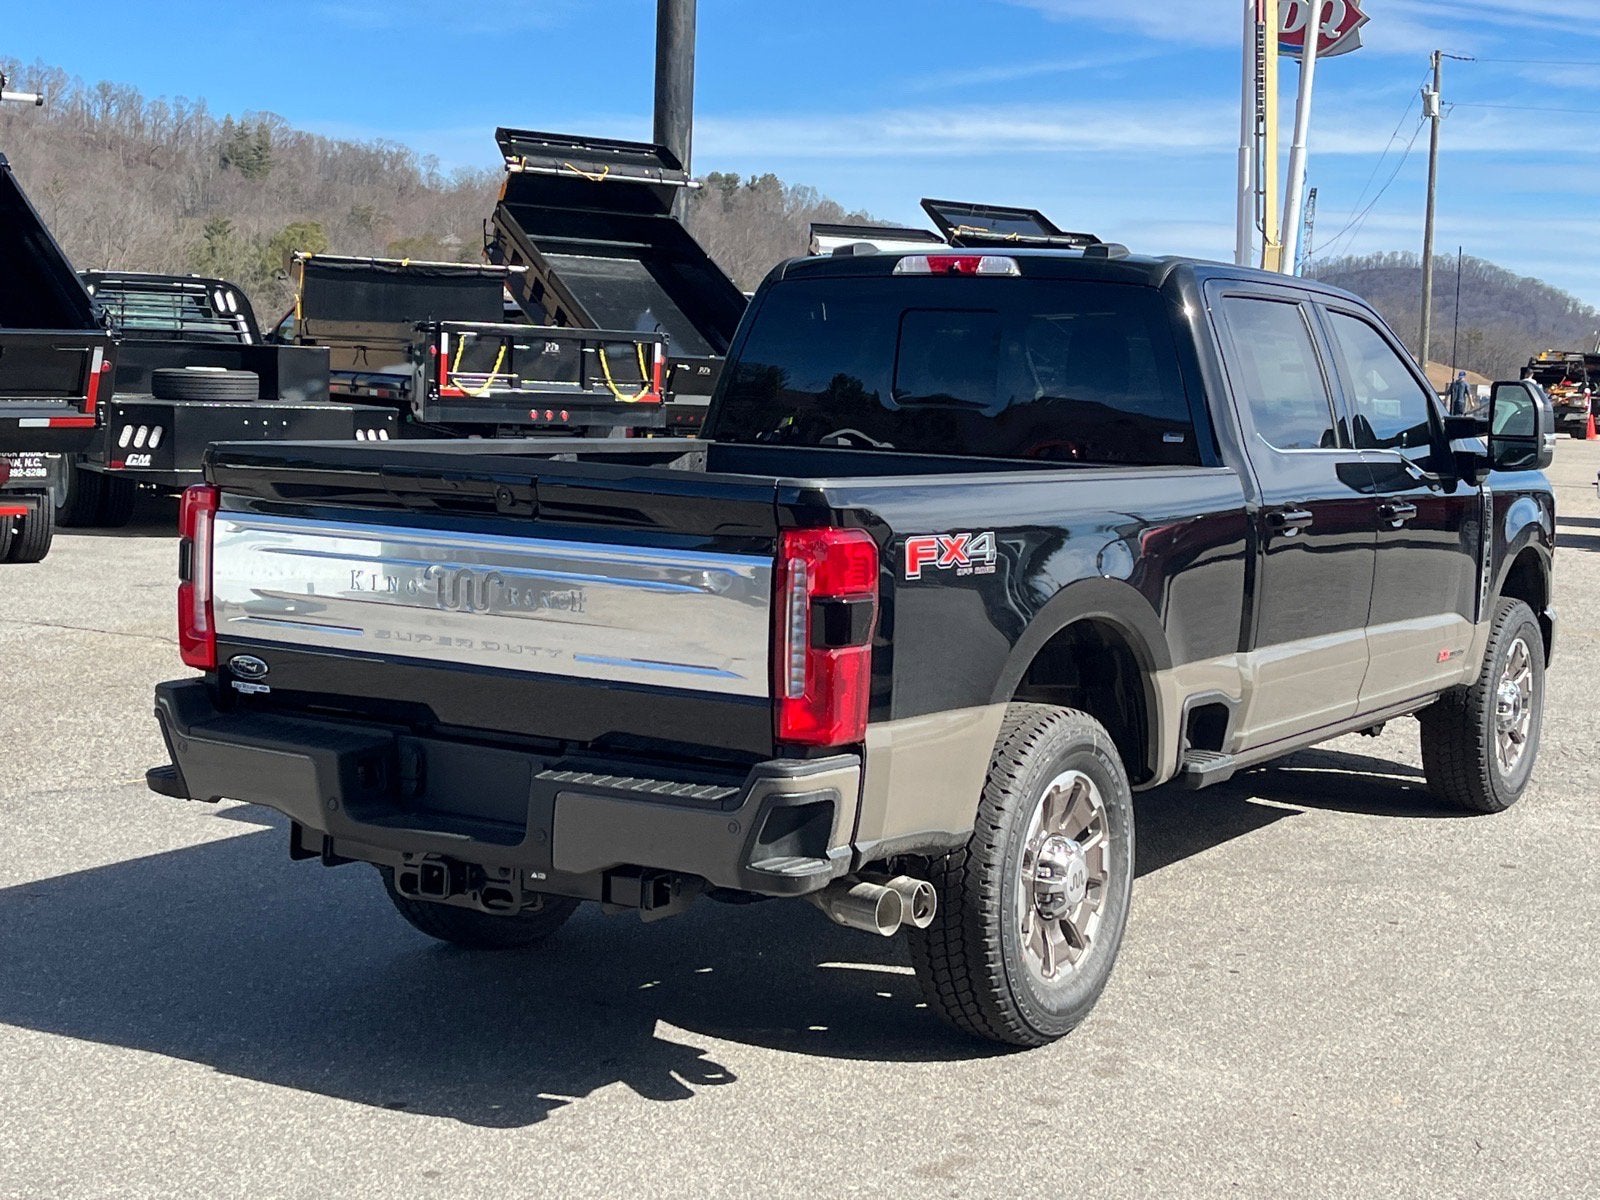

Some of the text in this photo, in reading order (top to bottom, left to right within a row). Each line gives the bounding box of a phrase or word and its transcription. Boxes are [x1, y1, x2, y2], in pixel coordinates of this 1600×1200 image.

[1278, 0, 1347, 39] DQ
[905, 531, 997, 580] FX4
[374, 629, 563, 658] SUPER DUTY
